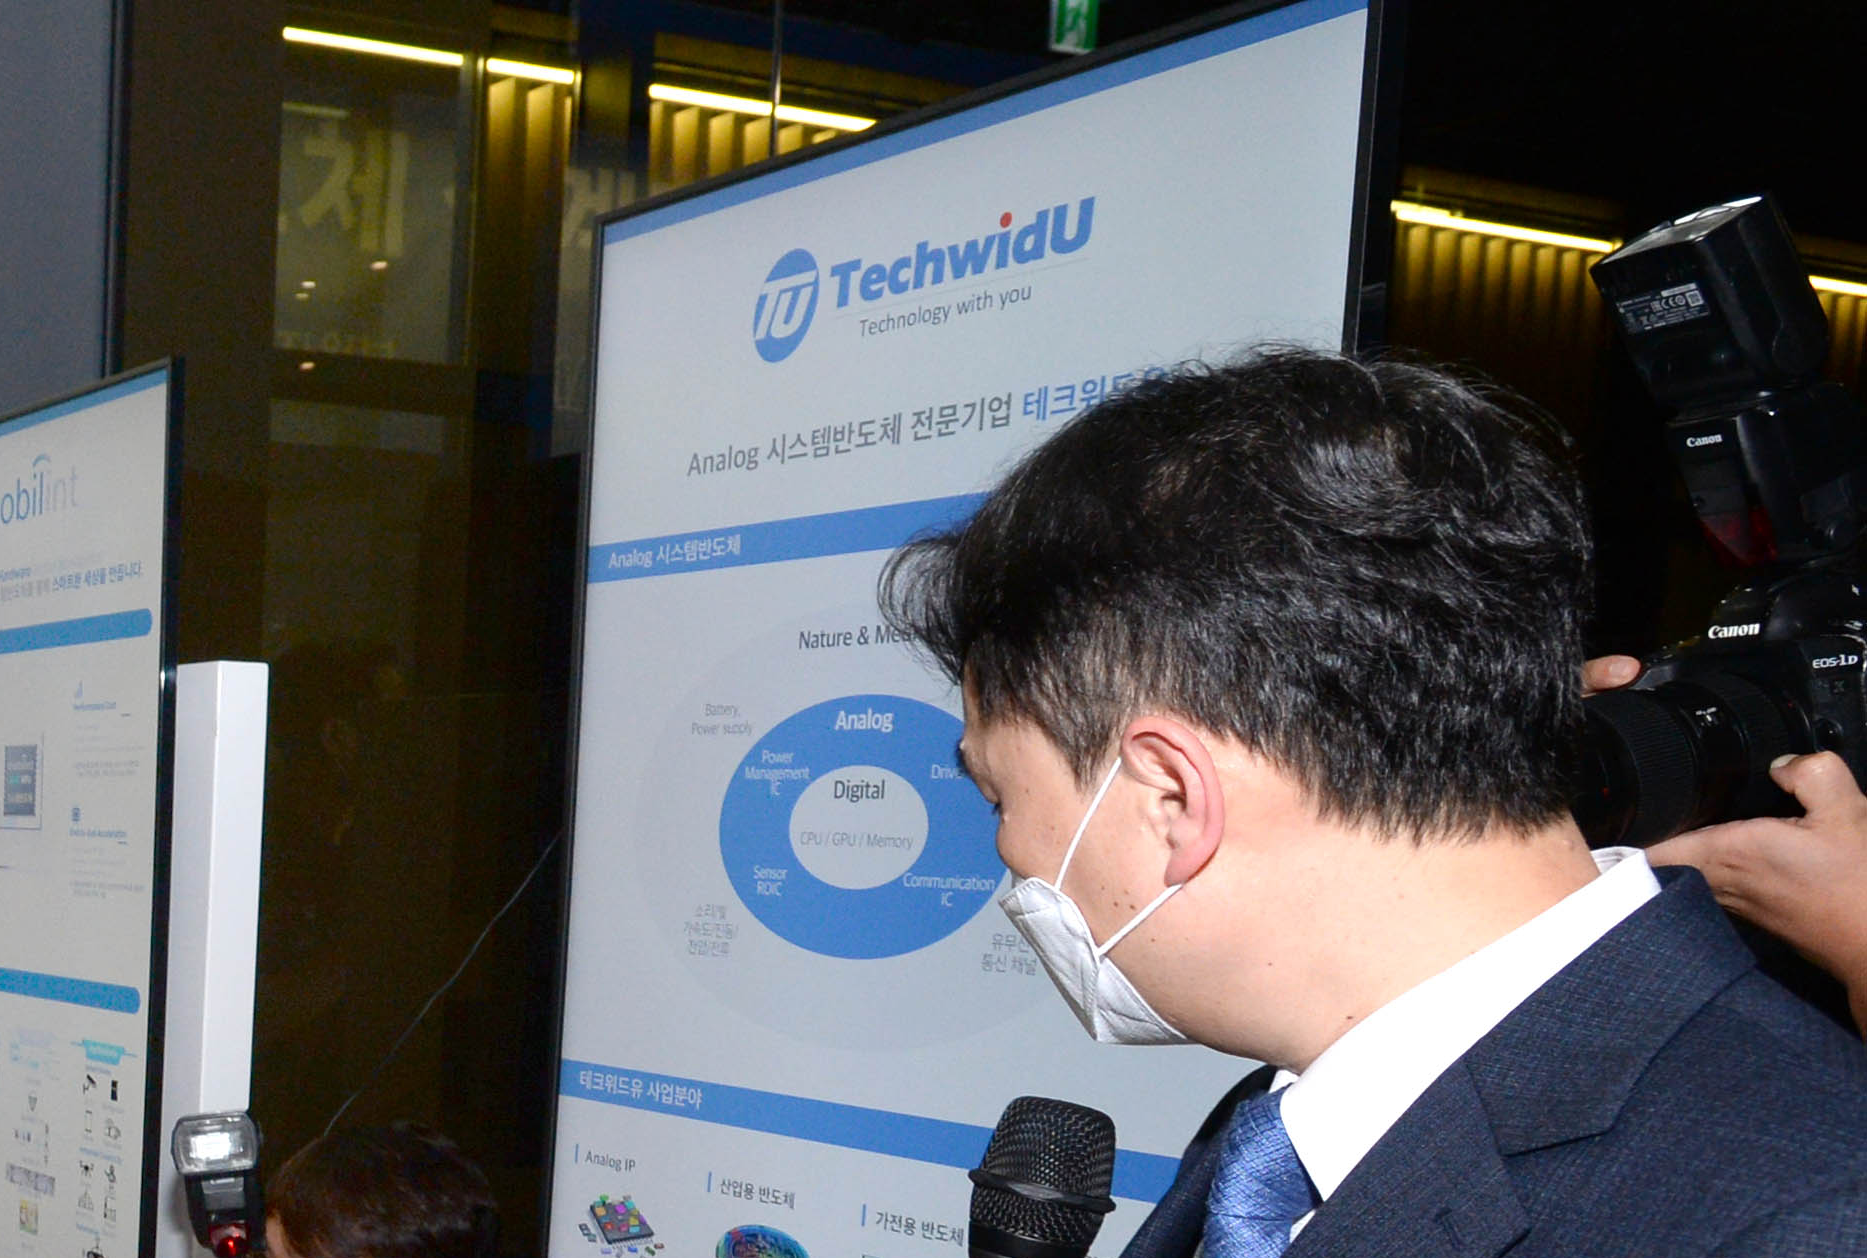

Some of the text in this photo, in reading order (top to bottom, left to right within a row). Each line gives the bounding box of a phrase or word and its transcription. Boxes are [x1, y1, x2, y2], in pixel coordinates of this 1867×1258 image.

[830, 196, 1096, 309] TechwidU
[859, 285, 1032, 337] Technology with you
[687, 444, 759, 477] Analog
[766, 412, 903, 466] 시스템반도체
[911, 393, 1012, 443] 전문기업
[1686, 433, 1723, 448] Canon
[608, 534, 741, 570] Analog 시스템반도체
[799, 629, 852, 650] Nature
[857, 625, 870, 645] &
[1708, 622, 1761, 639] Canon
[1812, 654, 1859, 669] EOS-1D
[835, 708, 894, 733] Analog
[761, 750, 794, 764] Power
[744, 766, 810, 781] Management
[833, 779, 885, 803] Digital
[800, 831, 823, 846] CPU
[832, 833, 857, 848] GPU
[867, 834, 914, 851] Memory
[753, 865, 788, 880] Sensor
[903, 873, 996, 891] Communication
[579, 1069, 703, 1111] 테크위드유 사업분야
[585, 1150, 636, 1173] Analog IP
[720, 1178, 796, 1211] 산업용 반도체
[875, 1209, 964, 1248] 가전용 반도체
